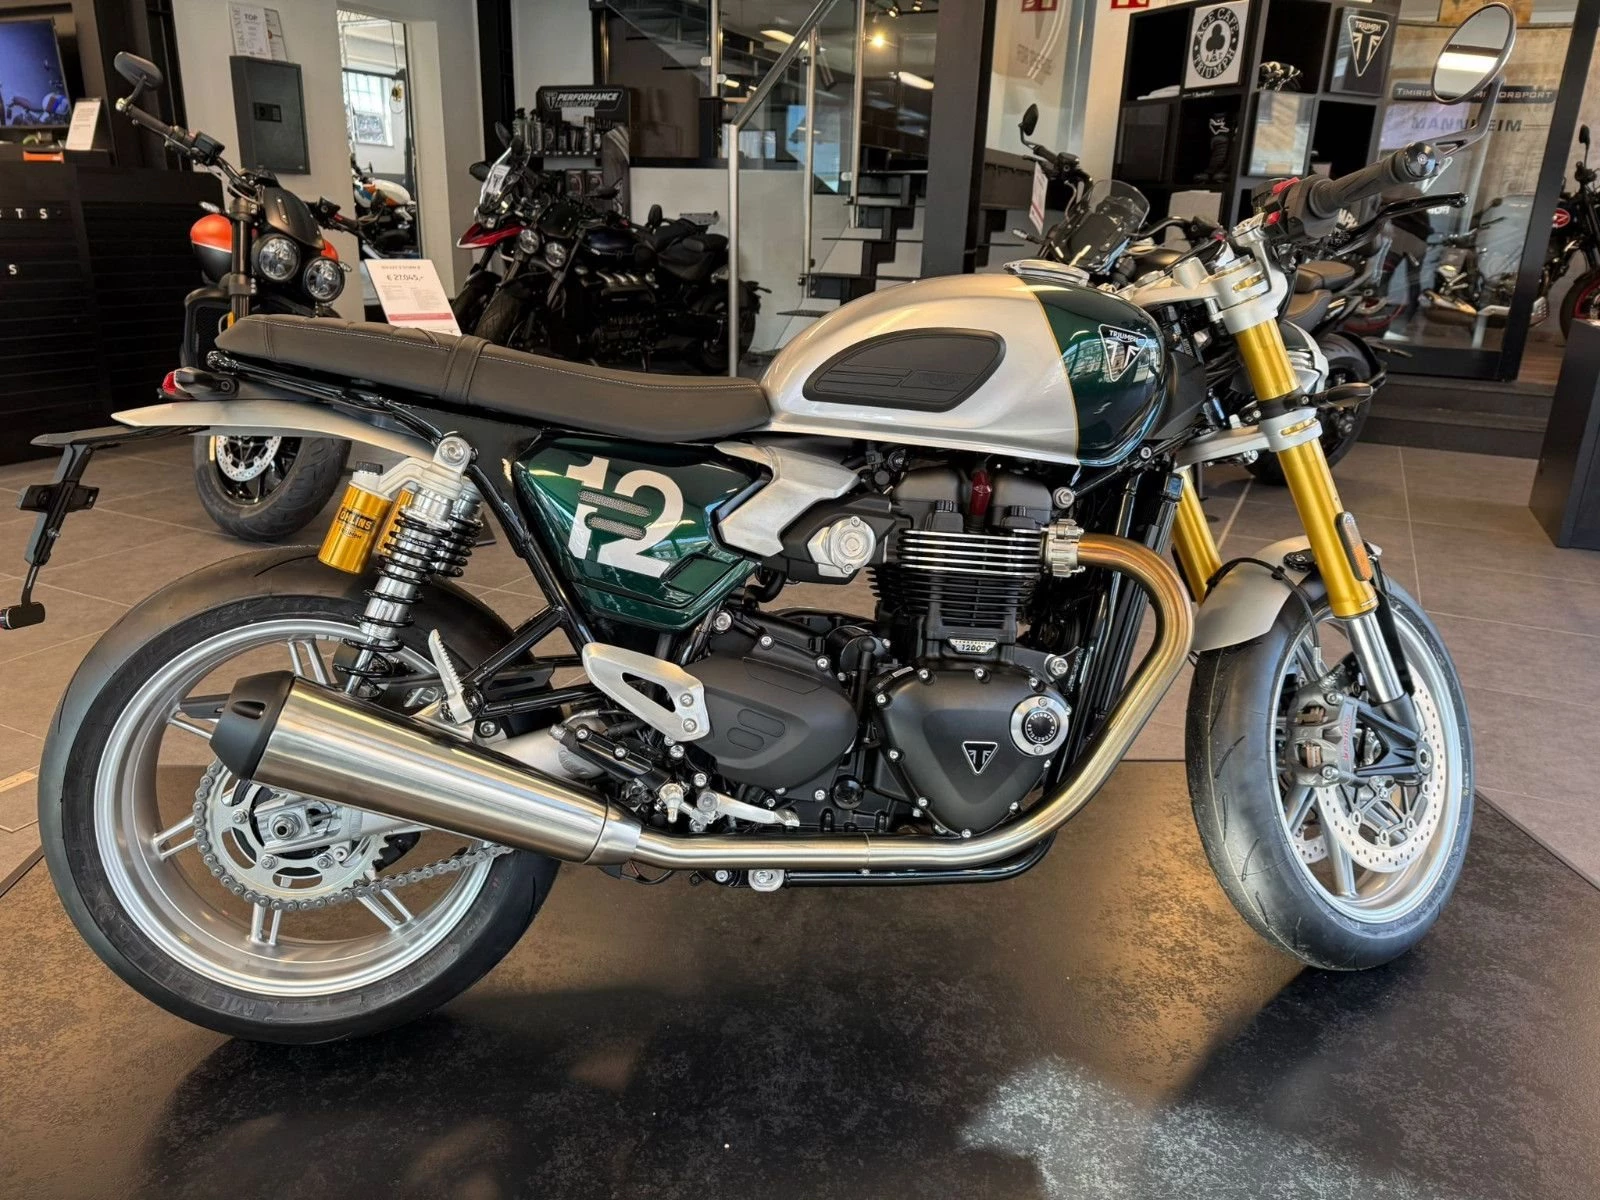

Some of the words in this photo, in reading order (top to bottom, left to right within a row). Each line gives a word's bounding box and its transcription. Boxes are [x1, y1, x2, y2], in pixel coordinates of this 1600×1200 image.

[1197, 12, 1216, 39] ACE
[1355, 20, 1381, 31] TRIUMPH
[1194, 48, 1236, 78] TRIUMPH
[557, 92, 619, 101] PERFORMANCE
[565, 455, 684, 579] 12
